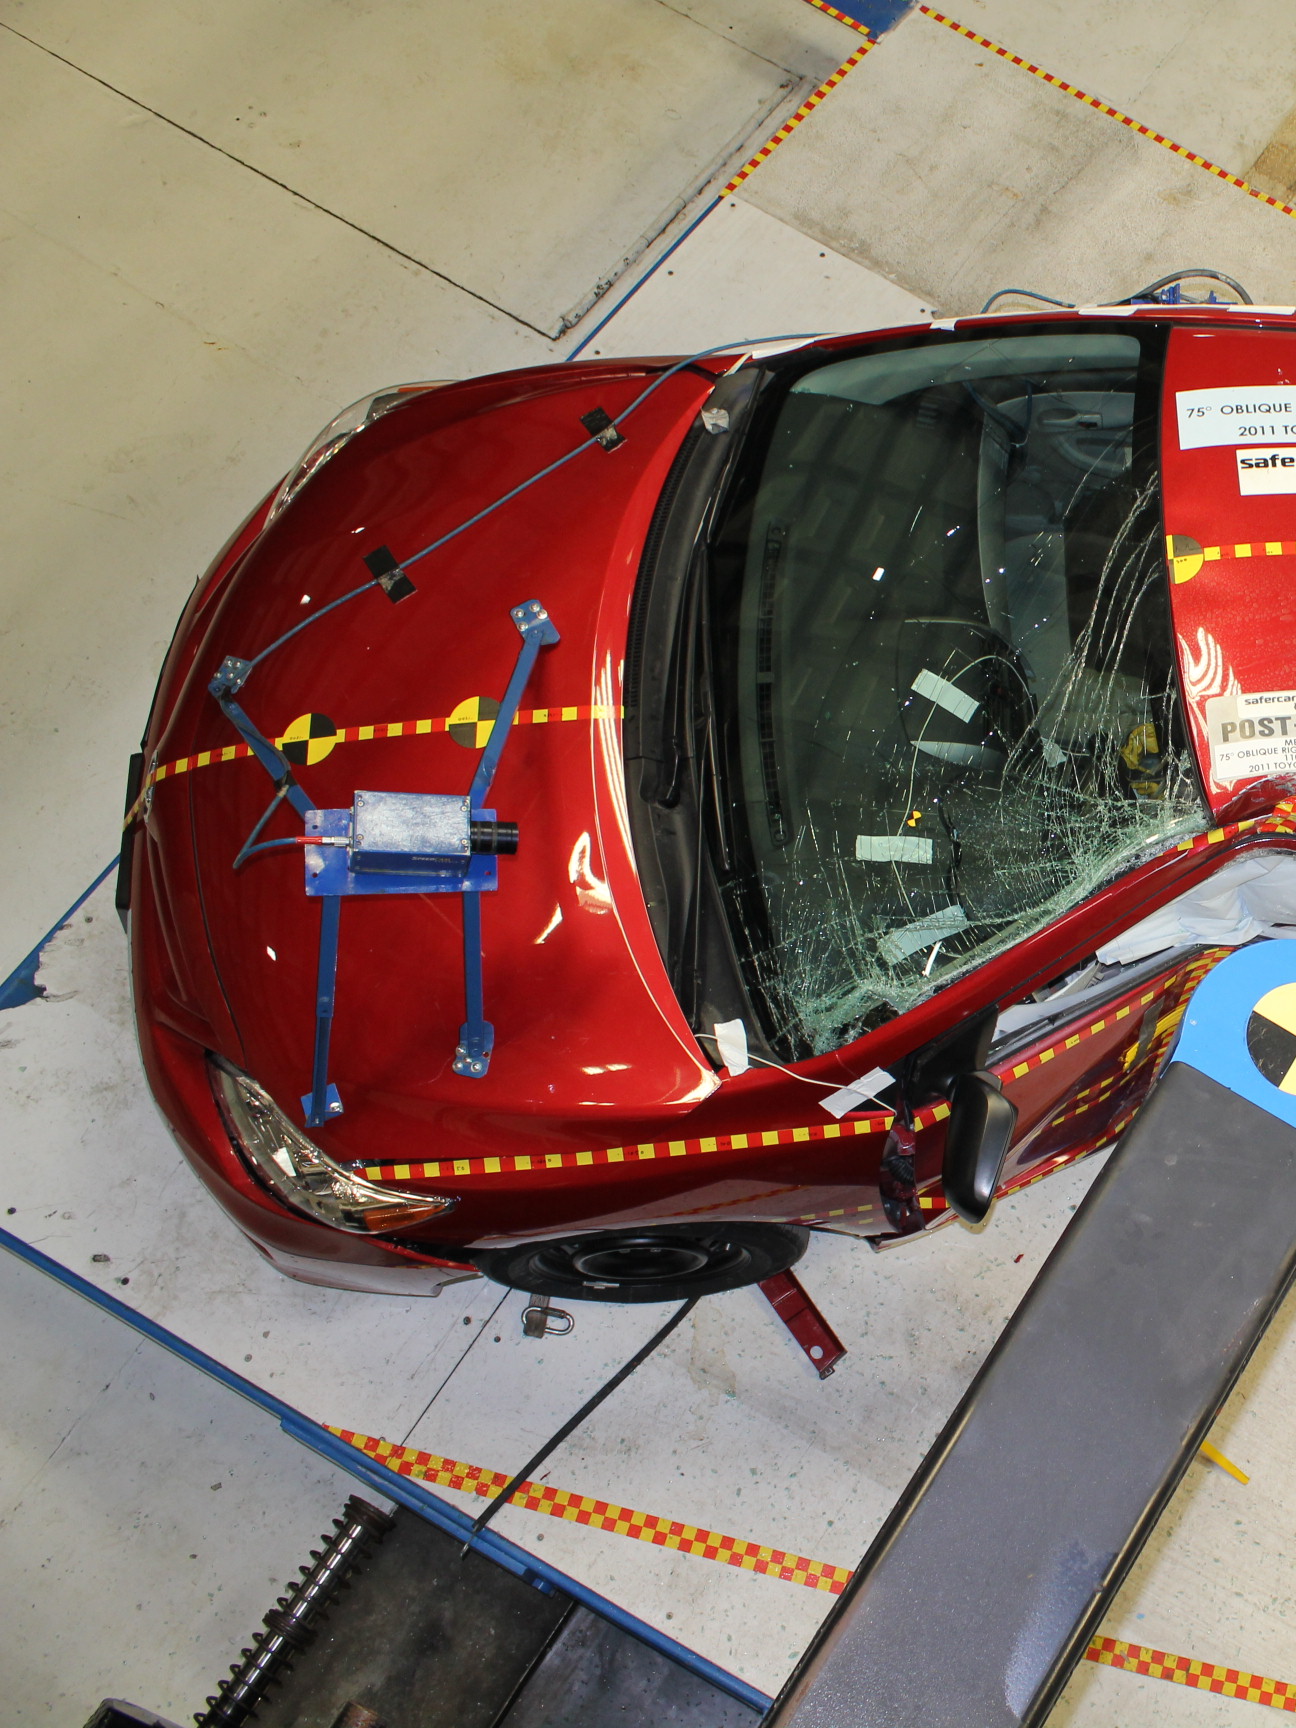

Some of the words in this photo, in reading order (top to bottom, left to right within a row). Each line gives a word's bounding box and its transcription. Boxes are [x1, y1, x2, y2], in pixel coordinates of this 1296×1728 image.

[1220, 402, 1293, 415] OBLIQUE
[1238, 425, 1275, 437] 2011
[1237, 747, 1279, 759] OBLIQUE
[1248, 763, 1271, 773] 2011
